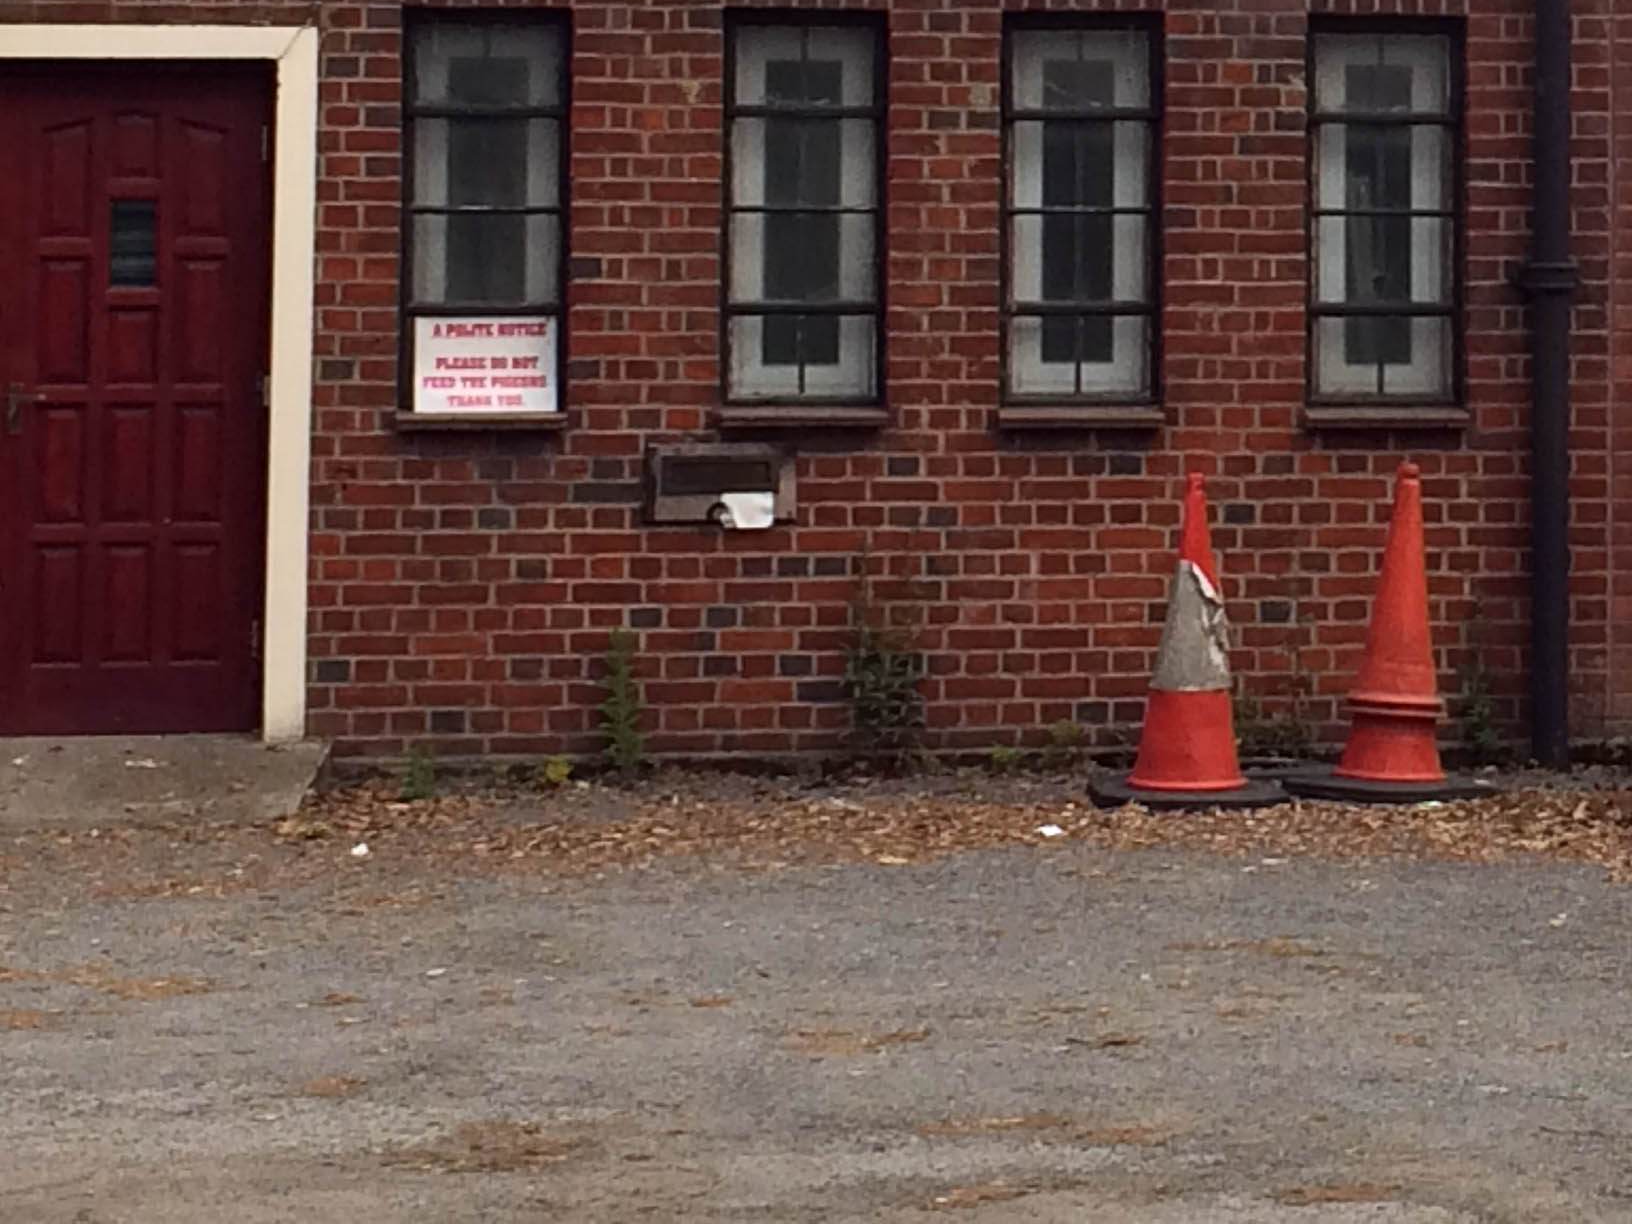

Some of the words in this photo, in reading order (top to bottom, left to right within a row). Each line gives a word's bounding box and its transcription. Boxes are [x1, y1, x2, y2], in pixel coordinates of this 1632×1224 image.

[432, 323, 443, 337] A
[446, 323, 494, 337] POLITE
[497, 323, 547, 337] NOTICE
[435, 357, 487, 370] PLEASE
[490, 357, 508, 370] DO
[512, 356, 539, 370] NOT
[423, 376, 456, 389] FEED
[461, 376, 487, 389] THE
[447, 395, 492, 407] THANK
